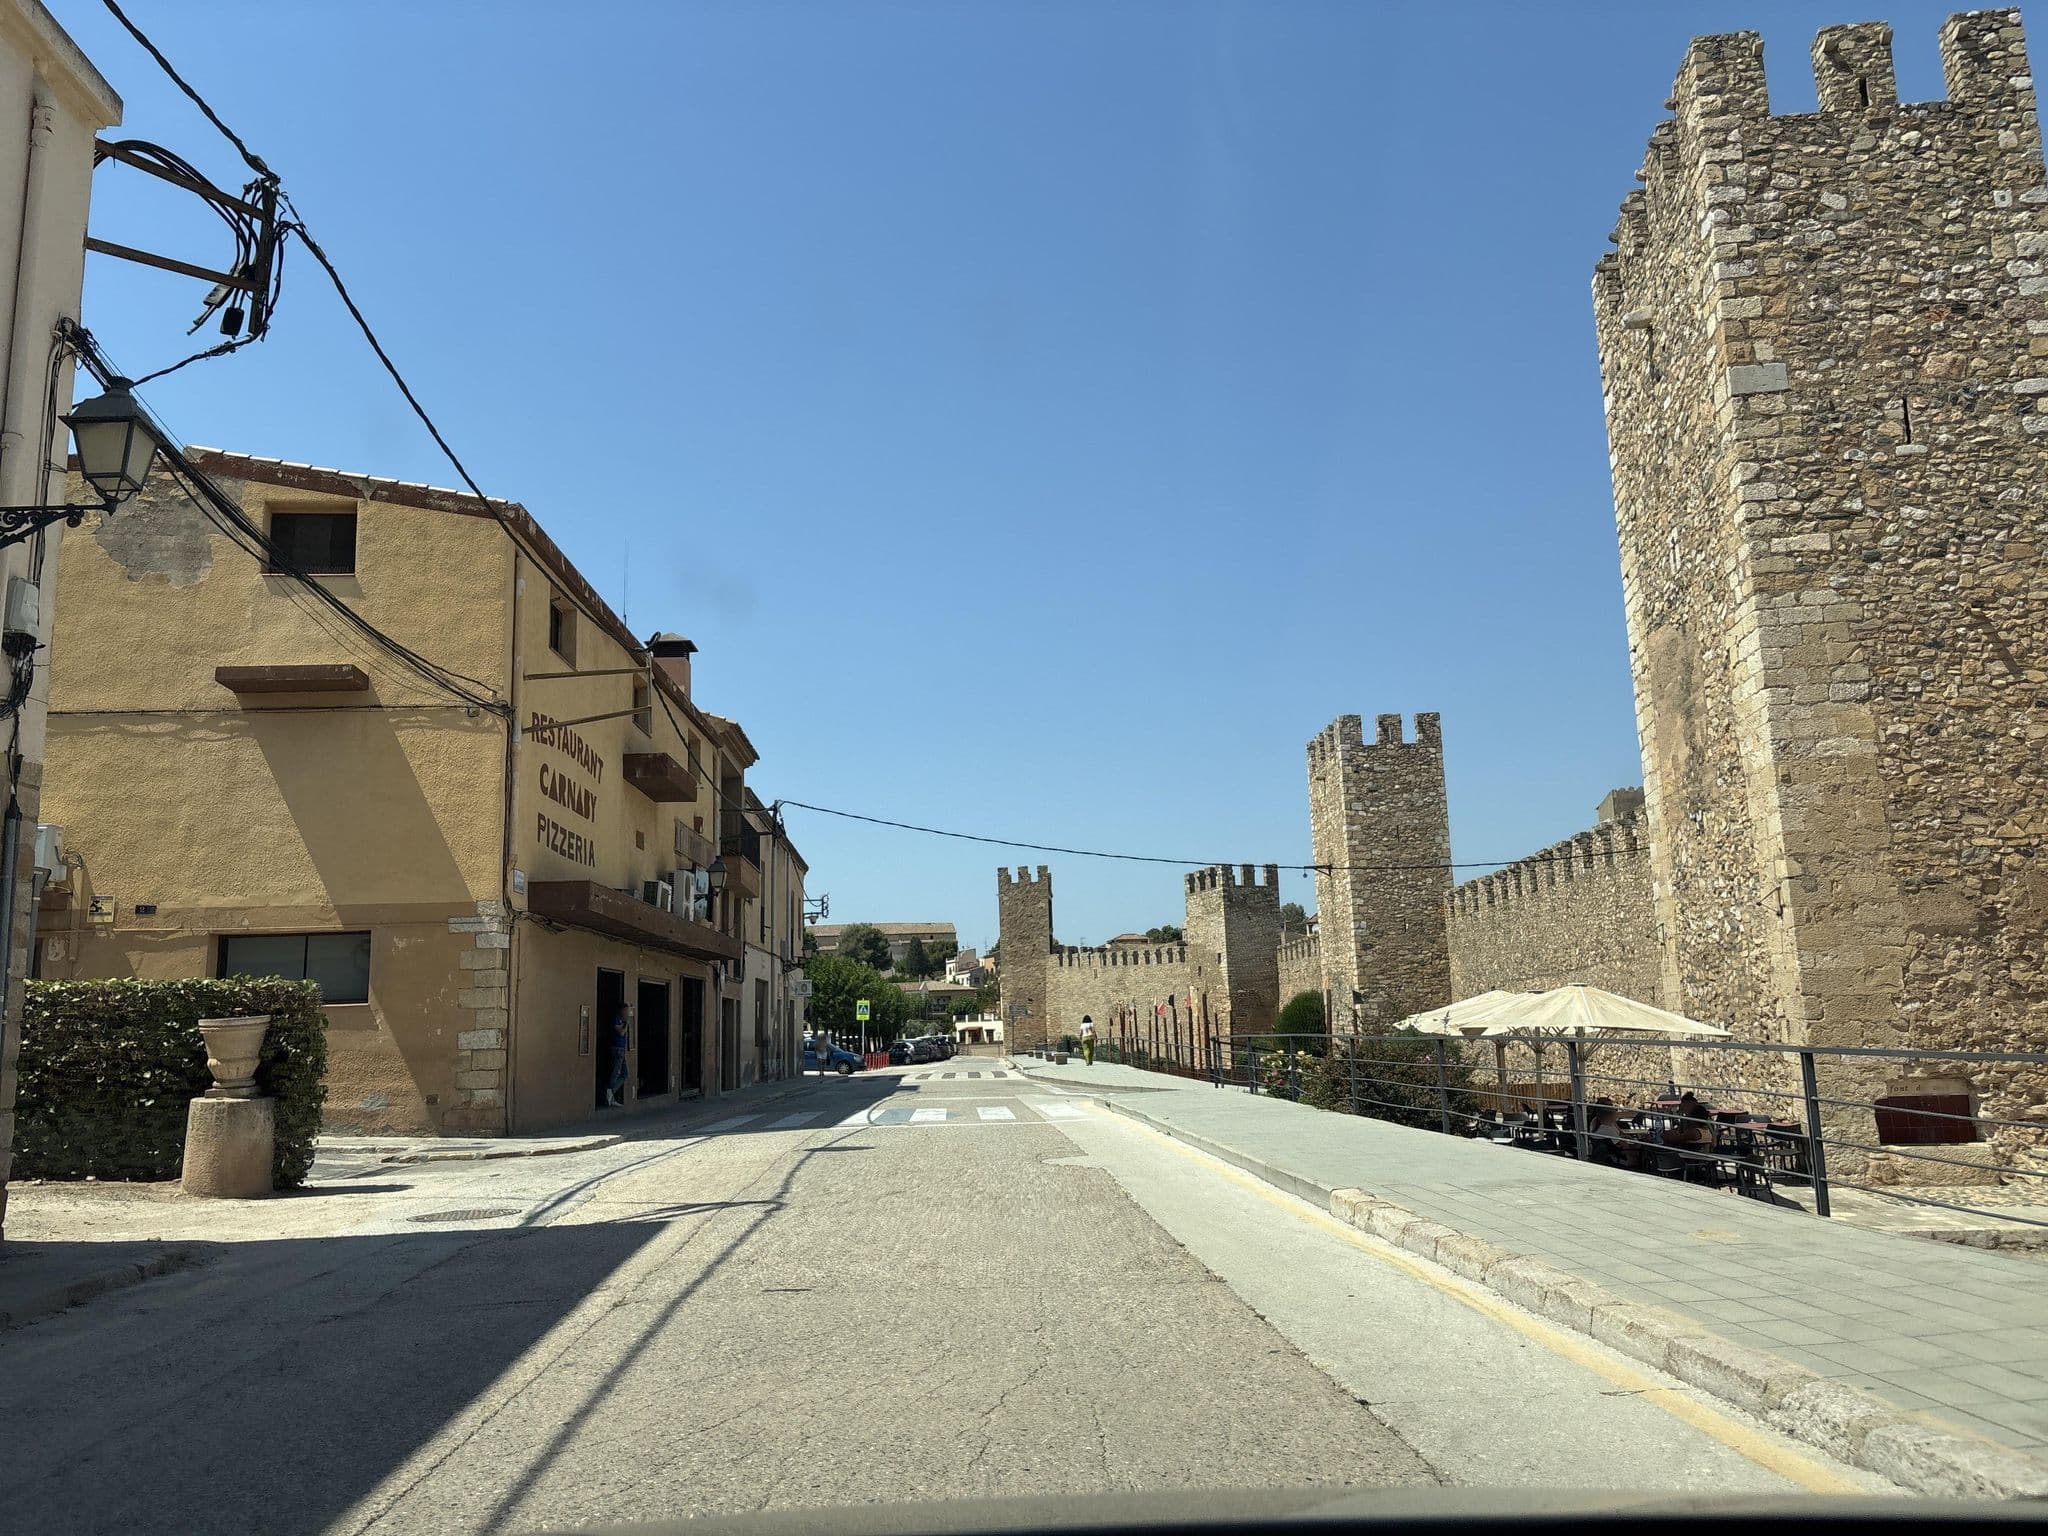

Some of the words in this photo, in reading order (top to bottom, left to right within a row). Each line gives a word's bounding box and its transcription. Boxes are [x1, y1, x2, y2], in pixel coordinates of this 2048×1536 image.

[532, 712, 604, 784] RESTAURANT
[539, 763, 597, 823] CARNABY
[537, 812, 596, 868] PIZZERIA
